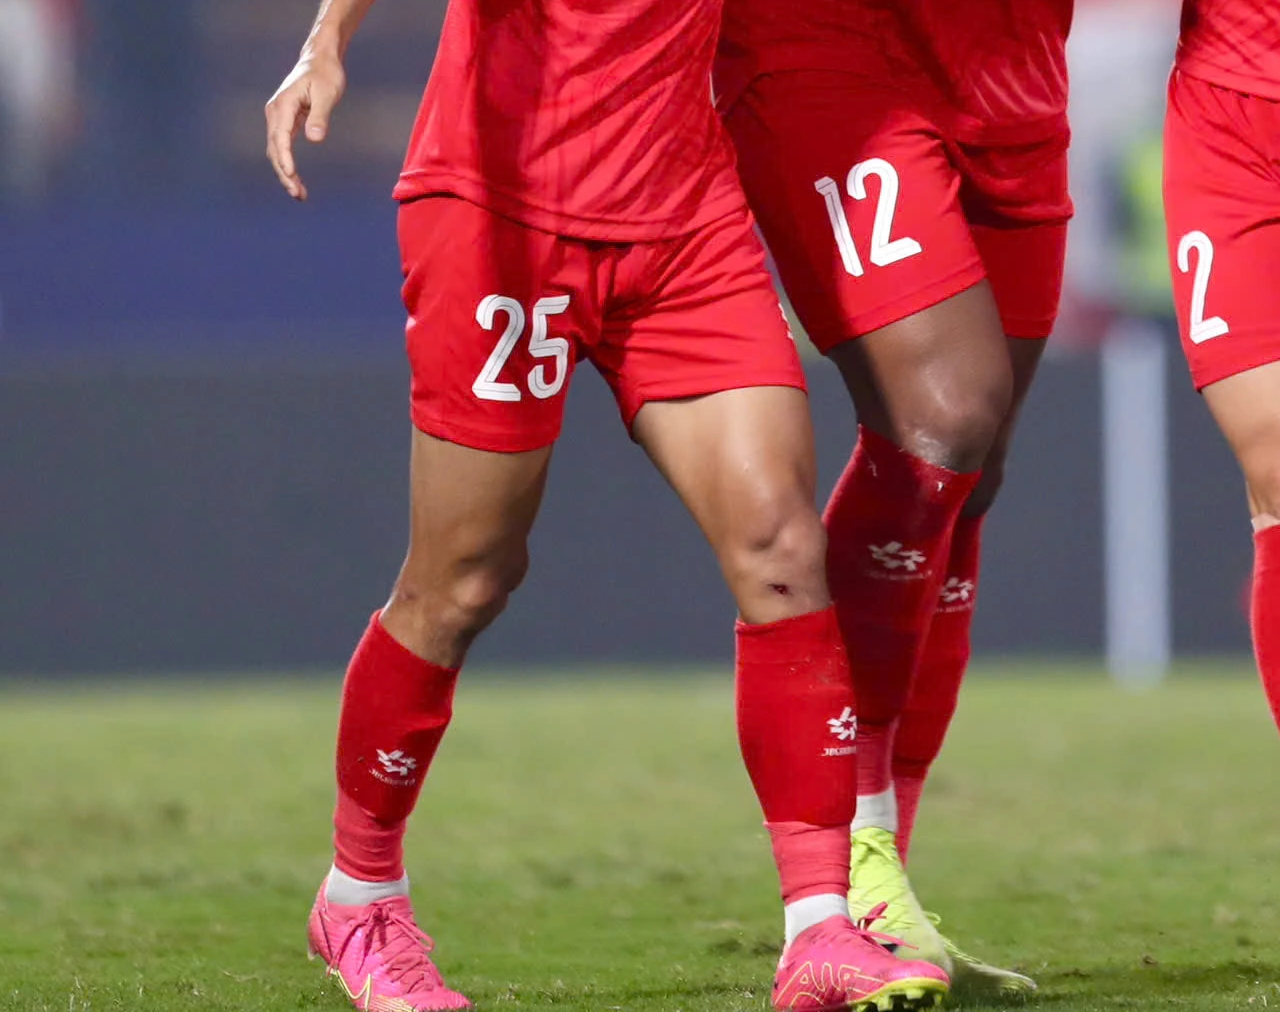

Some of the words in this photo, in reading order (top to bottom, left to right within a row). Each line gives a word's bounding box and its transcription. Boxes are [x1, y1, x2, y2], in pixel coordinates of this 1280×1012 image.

[815, 158, 922, 277] 12
[1178, 230, 1229, 344] 2
[472, 295, 570, 401] 25
